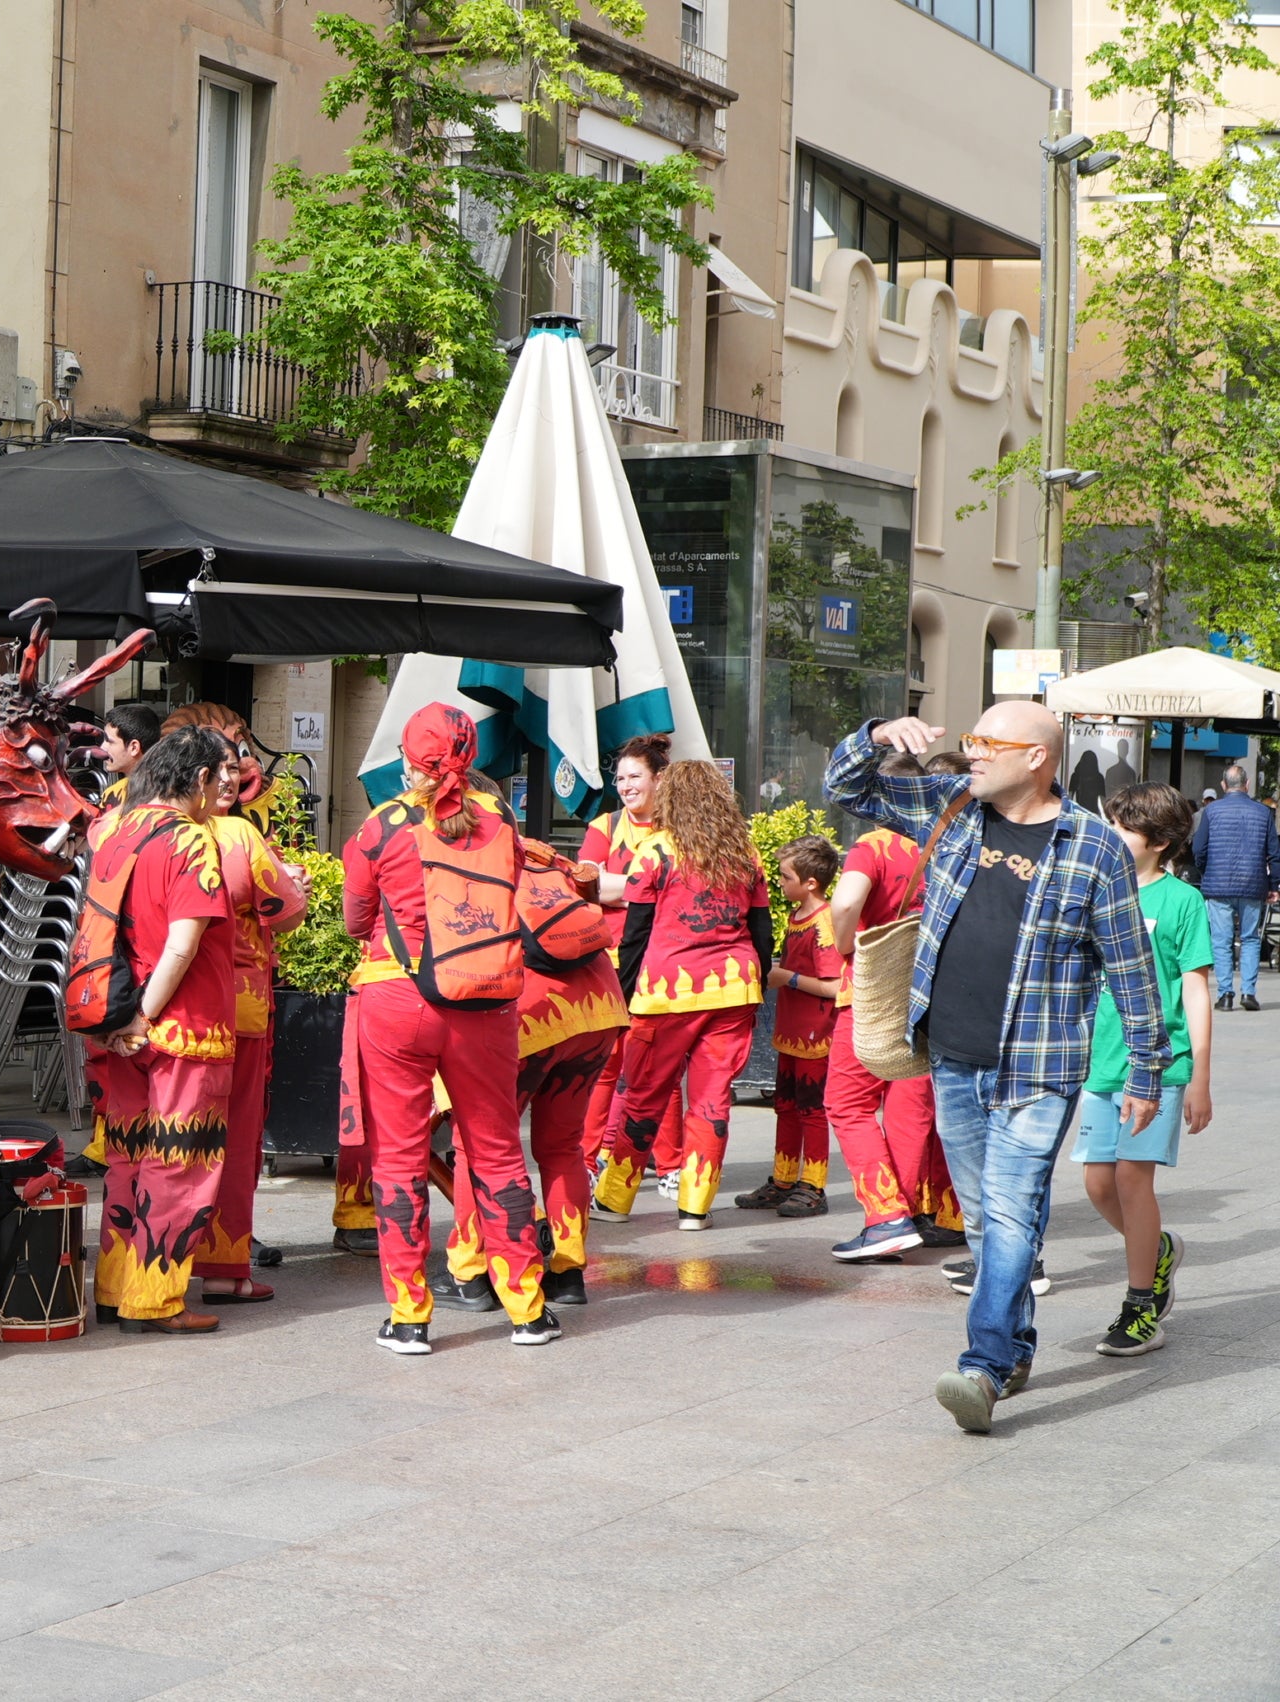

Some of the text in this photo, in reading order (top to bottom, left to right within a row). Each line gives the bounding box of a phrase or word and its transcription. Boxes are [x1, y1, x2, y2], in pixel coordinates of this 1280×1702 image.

[669, 551, 740, 562] d'Aparcaments
[826, 601, 852, 631] VIAT
[1105, 694, 1203, 713] SANTA CEREZA
